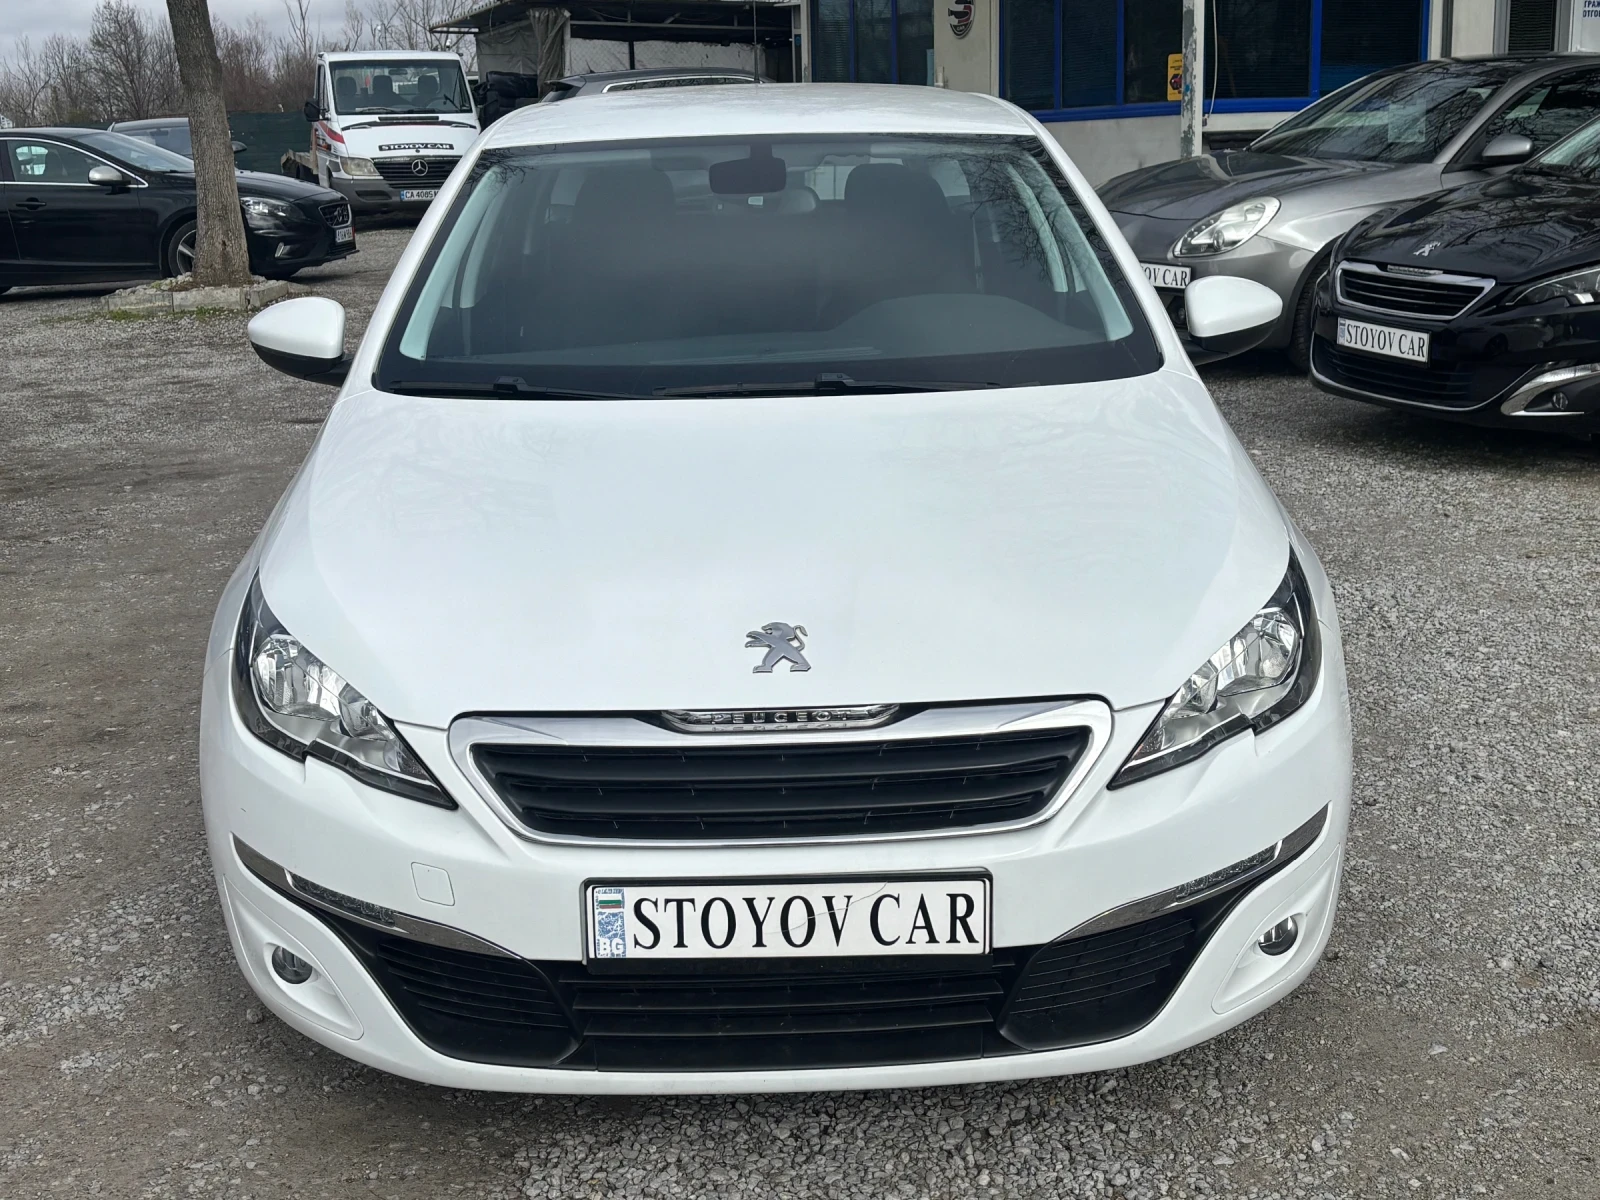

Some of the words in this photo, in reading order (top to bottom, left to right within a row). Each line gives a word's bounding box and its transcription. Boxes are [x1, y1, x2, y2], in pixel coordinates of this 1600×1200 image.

[1162, 268, 1188, 287] CAR
[1346, 323, 1396, 352] STOYOV
[1398, 333, 1425, 358] CAR
[713, 710, 848, 724] PEUGEOT
[633, 895, 853, 950] STOYOV
[870, 893, 980, 947] CAR
[600, 938, 624, 955] BG
